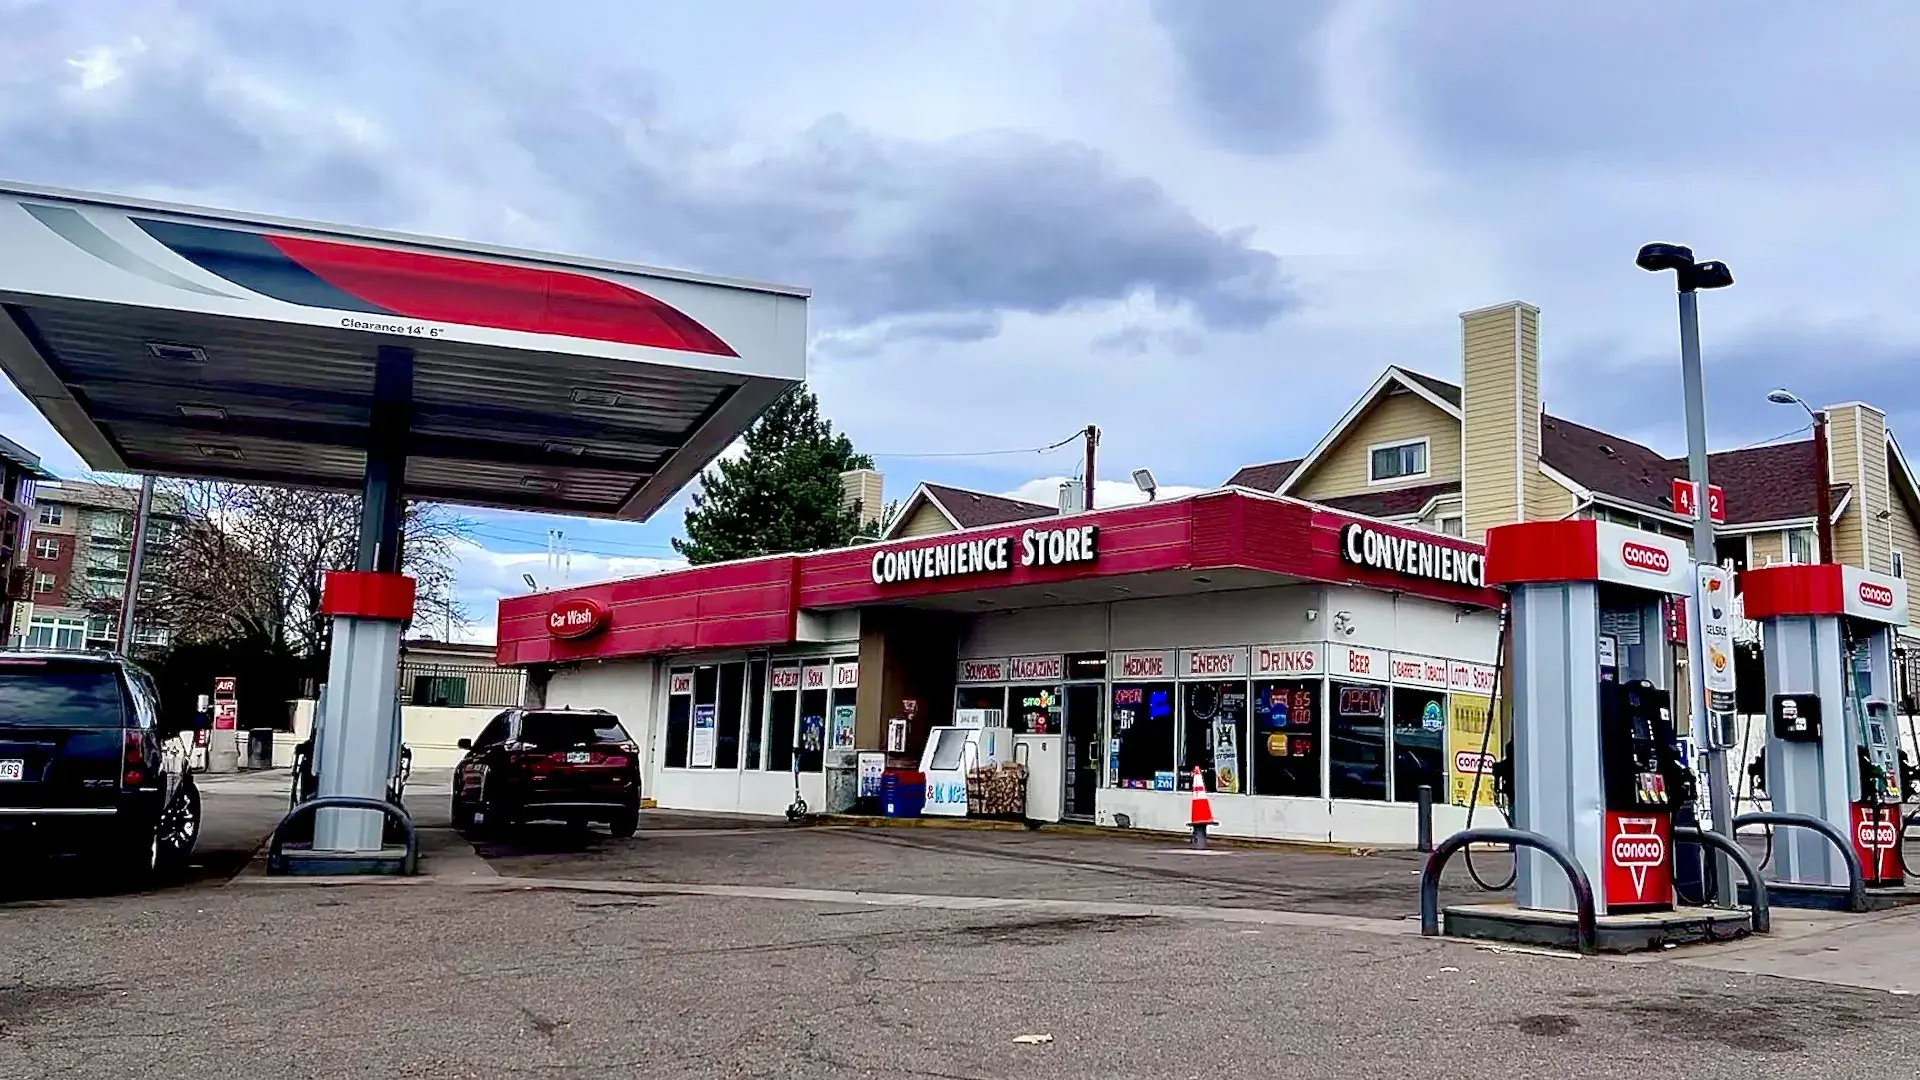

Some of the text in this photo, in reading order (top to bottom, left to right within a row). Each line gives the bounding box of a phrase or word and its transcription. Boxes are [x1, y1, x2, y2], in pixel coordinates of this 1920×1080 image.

[341, 318, 444, 337] Clearance 14' 6"
[1681, 490, 1688, 508] 4
[1710, 495, 1719, 512] 2
[872, 526, 1094, 584] CONVENIENCE STORE
[1624, 546, 1667, 568] conoco
[1860, 586, 1891, 603] conoco
[550, 608, 592, 627] Car Wash
[1012, 659, 1059, 678] MAGAZINE
[1123, 654, 1163, 676] MEDICINE
[1191, 653, 1235, 674] ENERGY
[1260, 649, 1314, 672] DRINKS
[1349, 649, 1370, 674] BEER
[838, 667, 858, 685] DELI
[217, 682, 234, 690] AIR
[1115, 688, 1142, 704] OPEN
[1342, 690, 1379, 712] OPEN
[1158, 779, 1173, 789] ZYN
[1616, 843, 1660, 858] conoco
